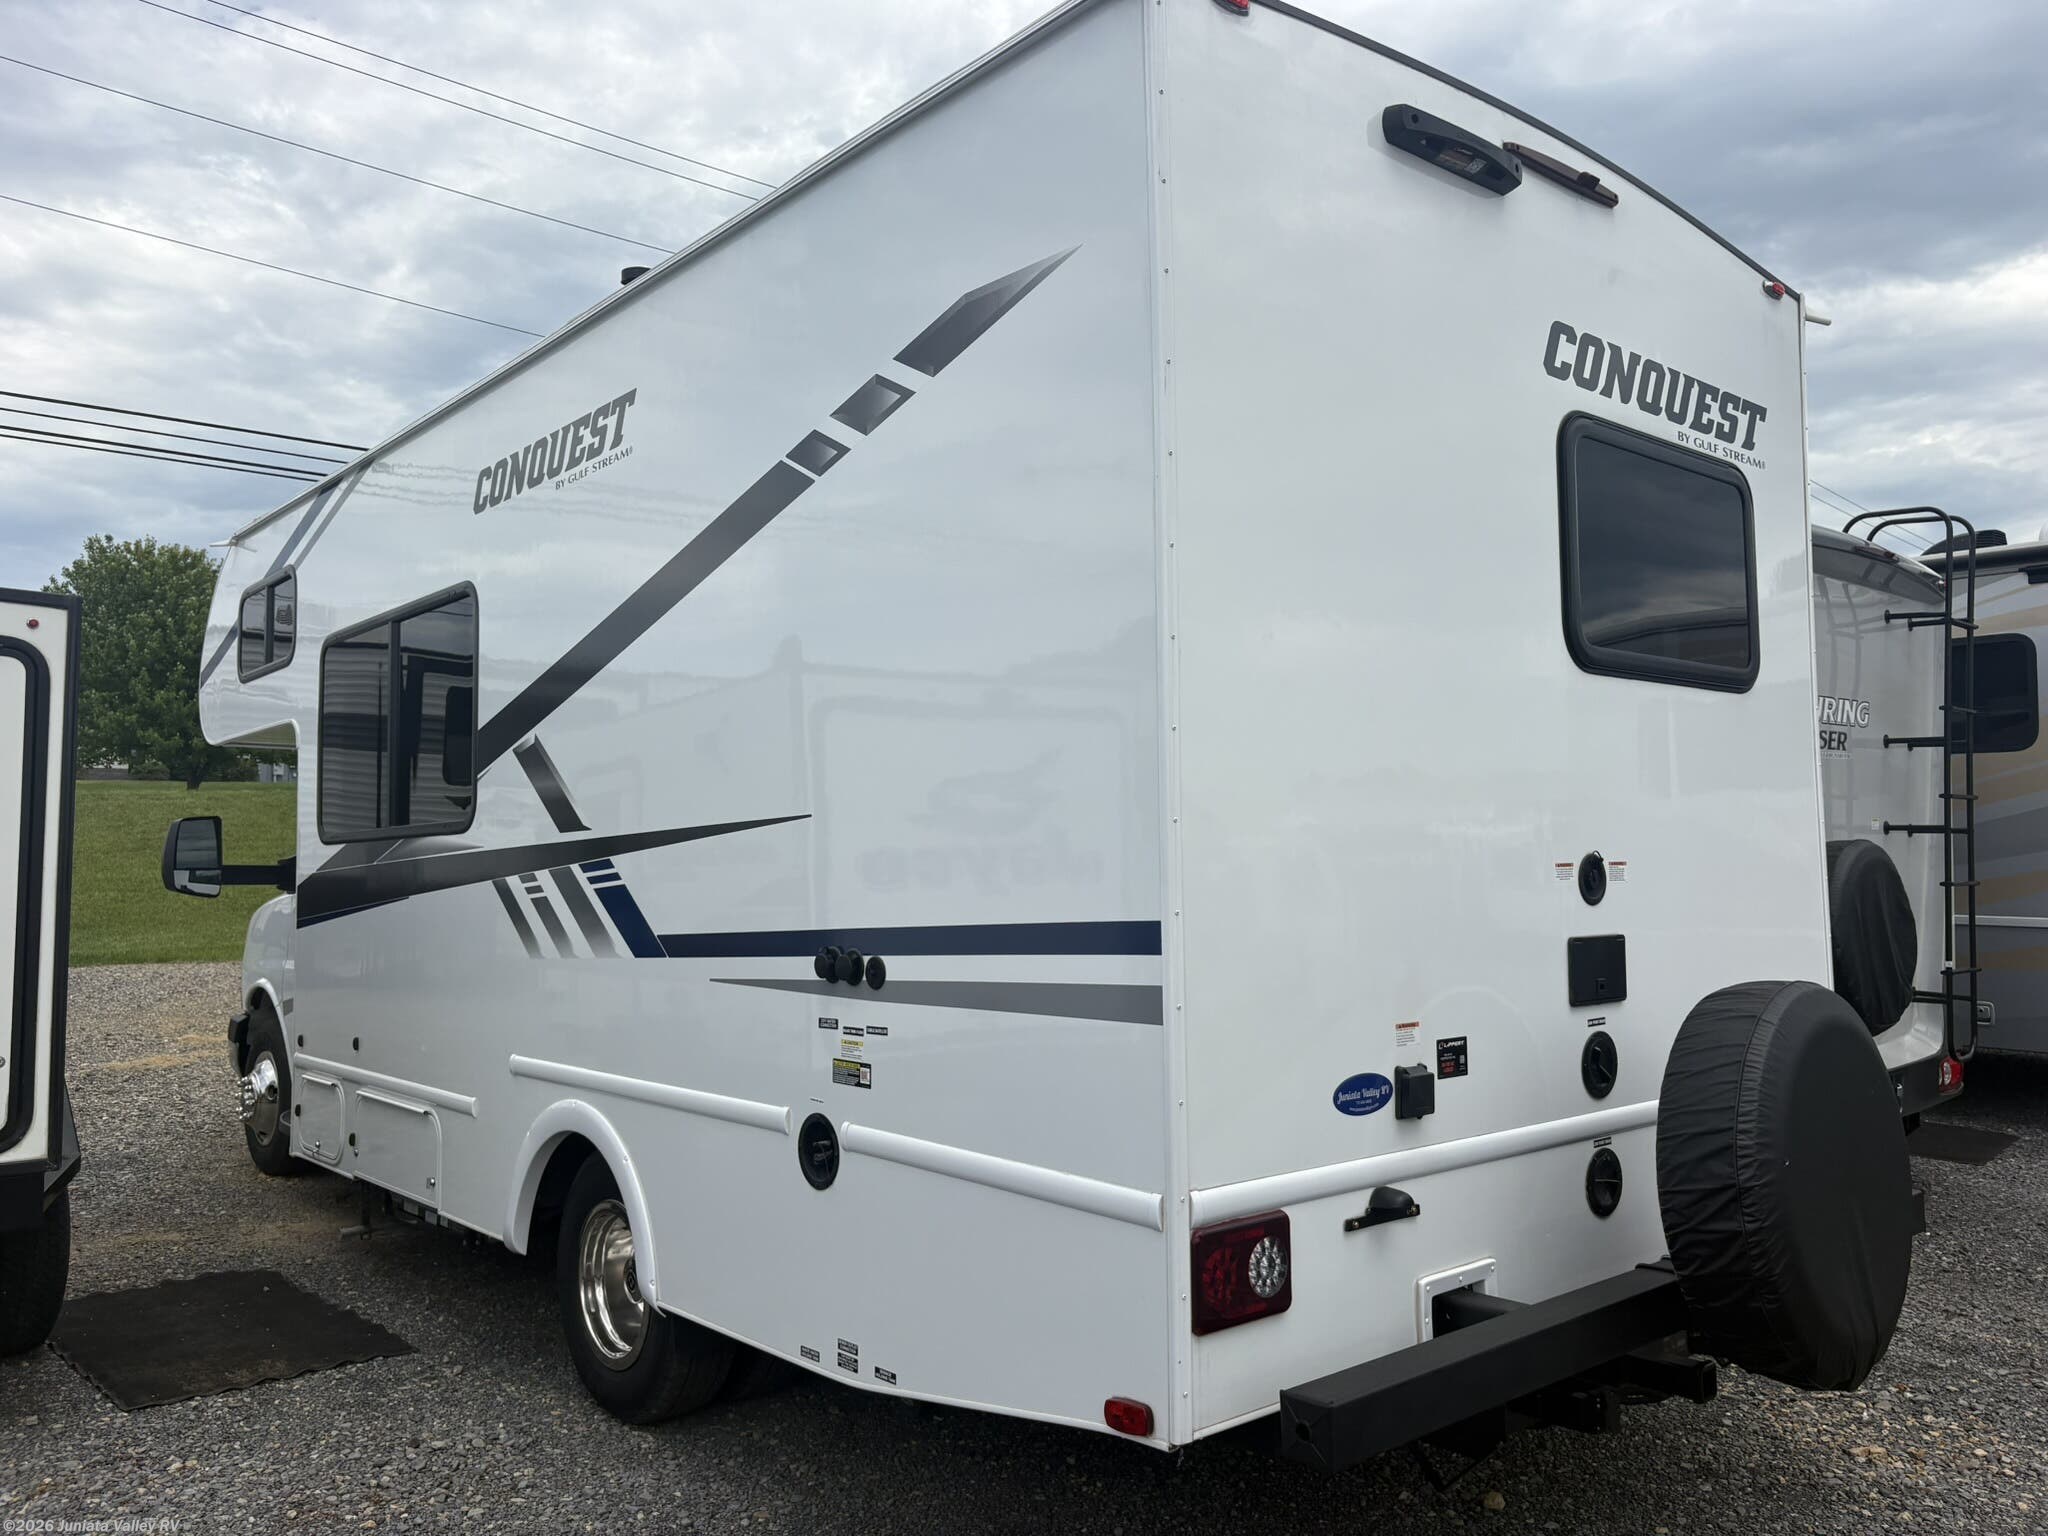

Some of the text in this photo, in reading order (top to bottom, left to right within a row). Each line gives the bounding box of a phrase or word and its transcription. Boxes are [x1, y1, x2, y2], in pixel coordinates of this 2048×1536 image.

[1543, 320, 1768, 451] CONQUEST
[473, 387, 637, 515] CONQUEST
[1677, 431, 1691, 444] BY
[1694, 437, 1720, 454] GULF
[555, 478, 567, 491] BY
[567, 466, 590, 484] GULF
[1362, 1087, 1380, 1099] Valley
